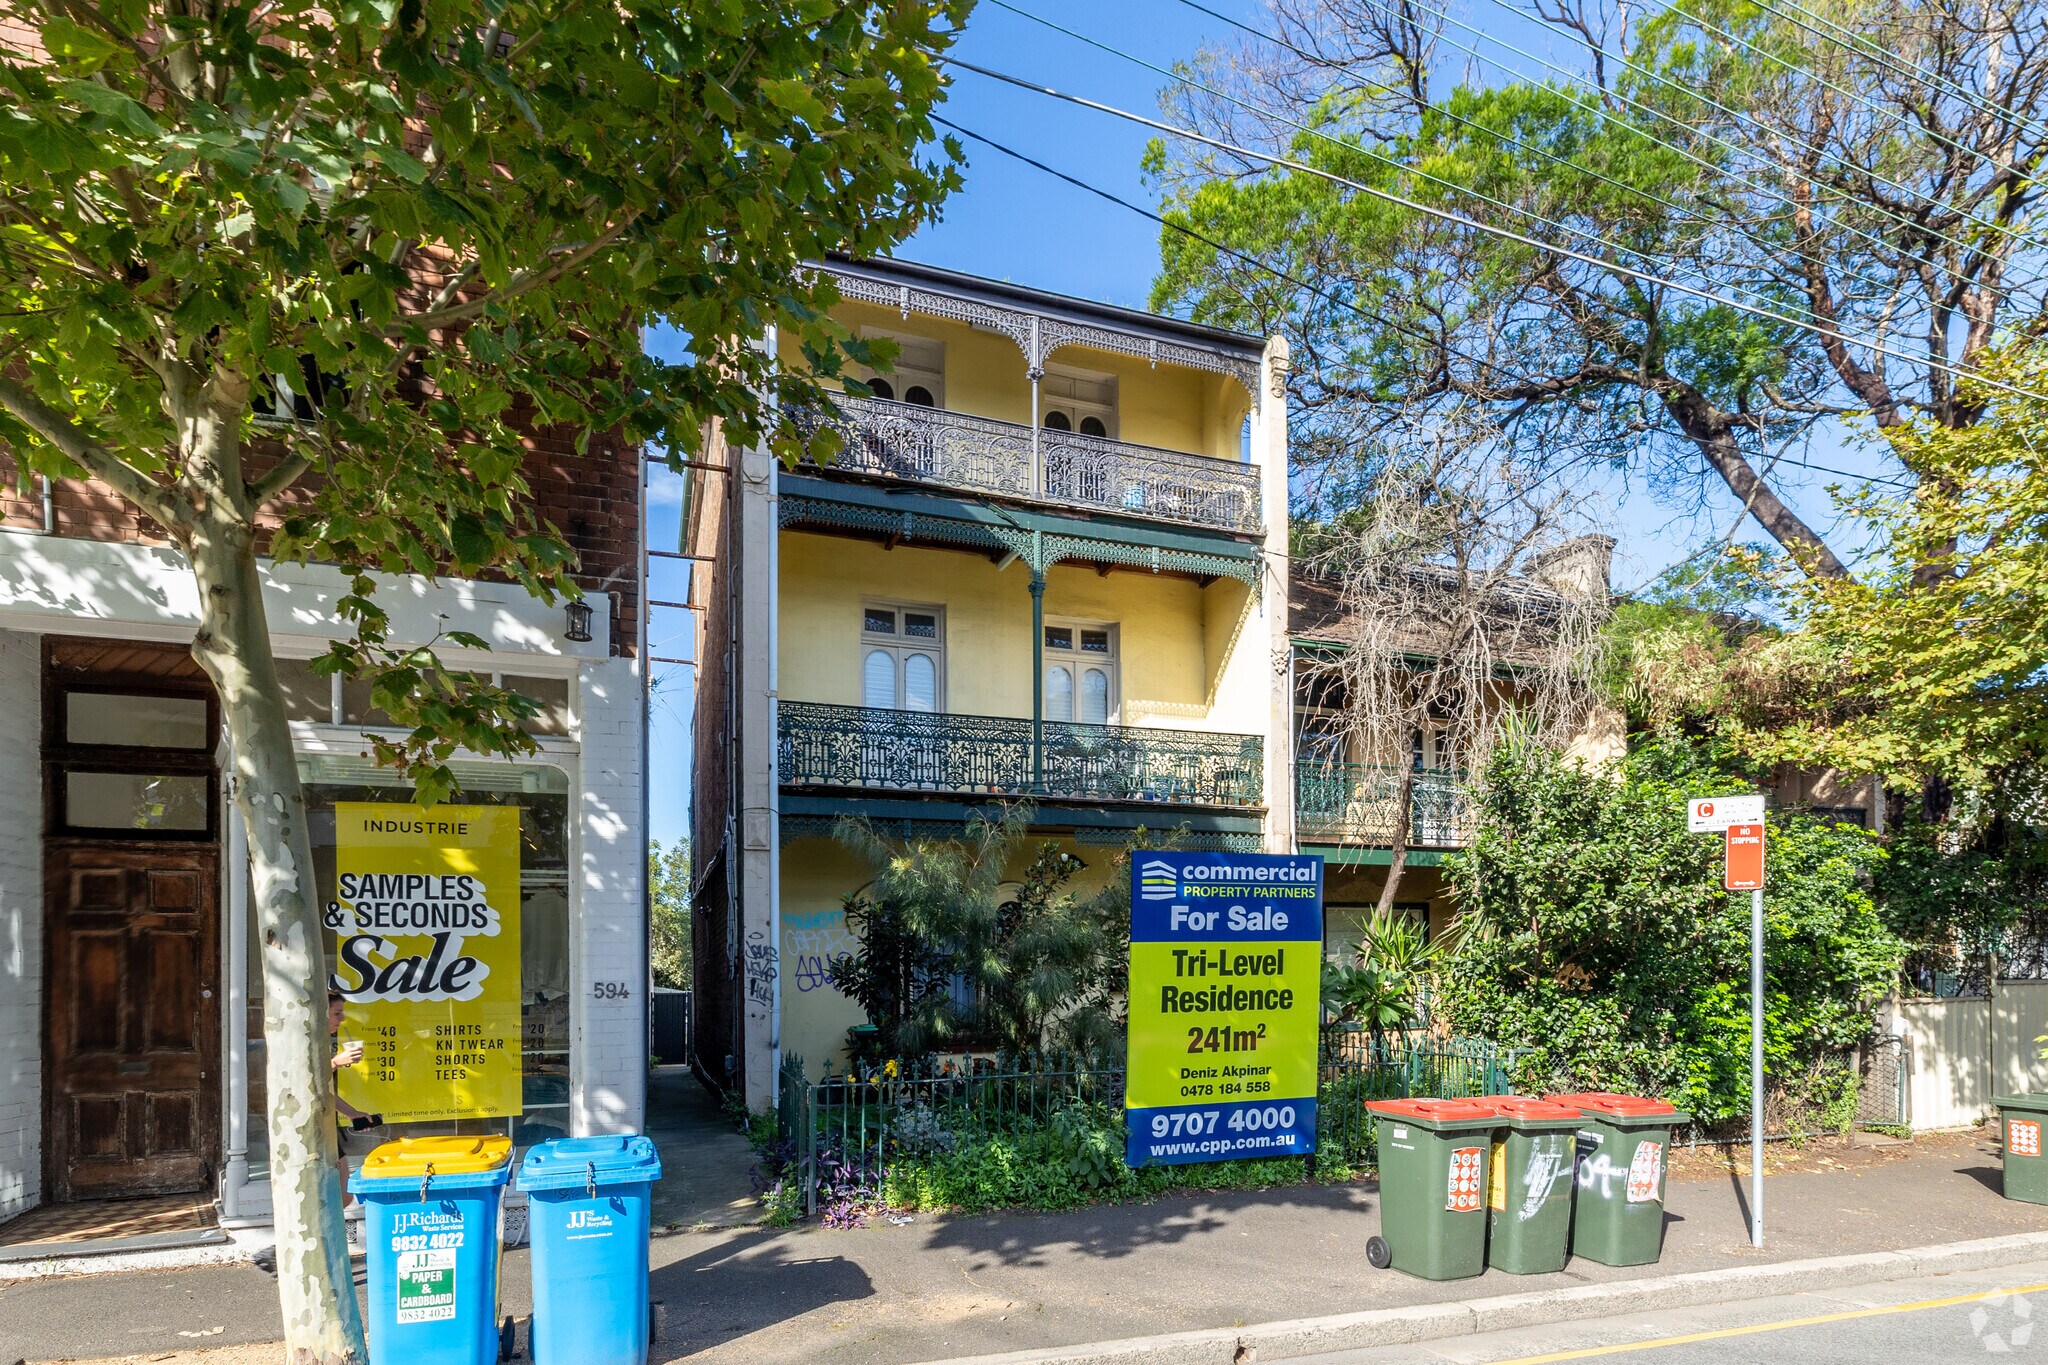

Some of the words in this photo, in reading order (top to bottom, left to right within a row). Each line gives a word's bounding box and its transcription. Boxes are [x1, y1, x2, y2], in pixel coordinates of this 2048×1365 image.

[364, 820, 468, 835] INDUSTRIE
[1182, 861, 1316, 882] commercial
[338, 873, 474, 900] SAMPLES
[1184, 886, 1250, 898] PROPERTY
[1253, 886, 1316, 898] PARTNERS
[323, 901, 346, 928] &
[355, 901, 488, 928] SECONDS
[1170, 905, 1220, 931] For
[1227, 905, 1289, 931] Sale
[329, 932, 476, 994] Sale
[1172, 949, 1284, 977] Tri-Level
[594, 982, 630, 999] 594
[1161, 984, 1294, 1013] Residence
[377, 1026, 396, 1037] $40
[436, 1025, 481, 1035] SHIRTS
[377, 1041, 396, 1051] $35
[1187, 1023, 1266, 1054] 241m²
[377, 1056, 395, 1067] $30
[436, 1054, 486, 1065] SHORTS
[376, 1070, 395, 1081] $30
[436, 1070, 466, 1080] TEES
[1180, 1067, 1218, 1079] Deniz
[1221, 1065, 1272, 1078] Akpinar
[1180, 1084, 1213, 1097] 0478
[1218, 1083, 1241, 1094] 184
[1246, 1081, 1271, 1093] 558
[1152, 1111, 1220, 1137] 9707
[1227, 1106, 1295, 1132] 4000
[1150, 1133, 1295, 1156] www.cpp.com.au
[392, 1211, 464, 1234] J.J.Richards
[392, 1234, 428, 1252] 9832
[430, 1232, 464, 1249] 4022
[412, 1271, 443, 1283] PAPER
[421, 1284, 432, 1294] &
[401, 1293, 452, 1308] CARDBOARD
[401, 1310, 425, 1321] 9832
[429, 1307, 452, 1318] 4022
